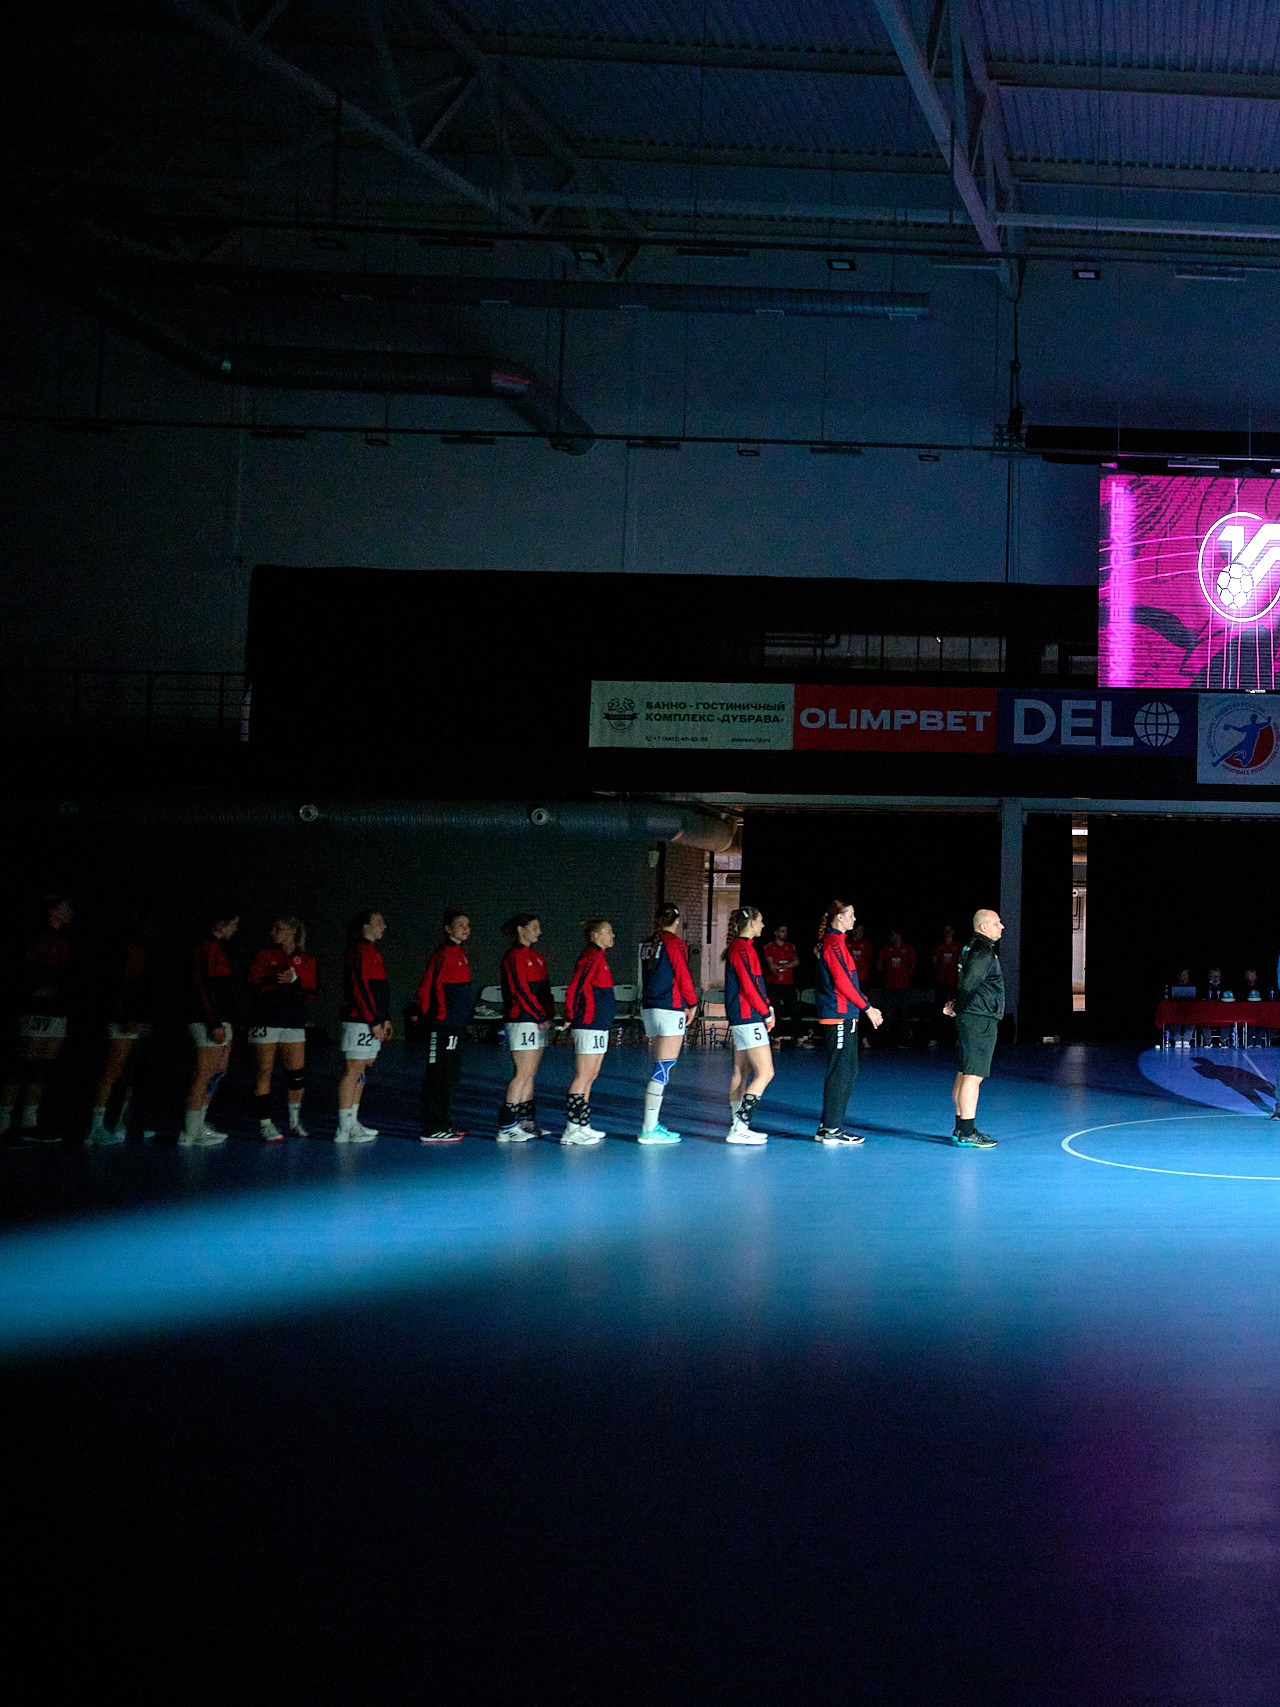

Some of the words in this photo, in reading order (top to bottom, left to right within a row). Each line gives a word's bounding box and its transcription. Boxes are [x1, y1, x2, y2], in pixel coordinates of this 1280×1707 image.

[645, 701, 687, 710] БАННО
[645, 713, 715, 722] КОМПЛЕКС
[800, 706, 992, 733] OLIMPBET
[357, 1032, 375, 1047] 22
[521, 1032, 535, 1046] 14
[754, 1027, 762, 1041] 5
